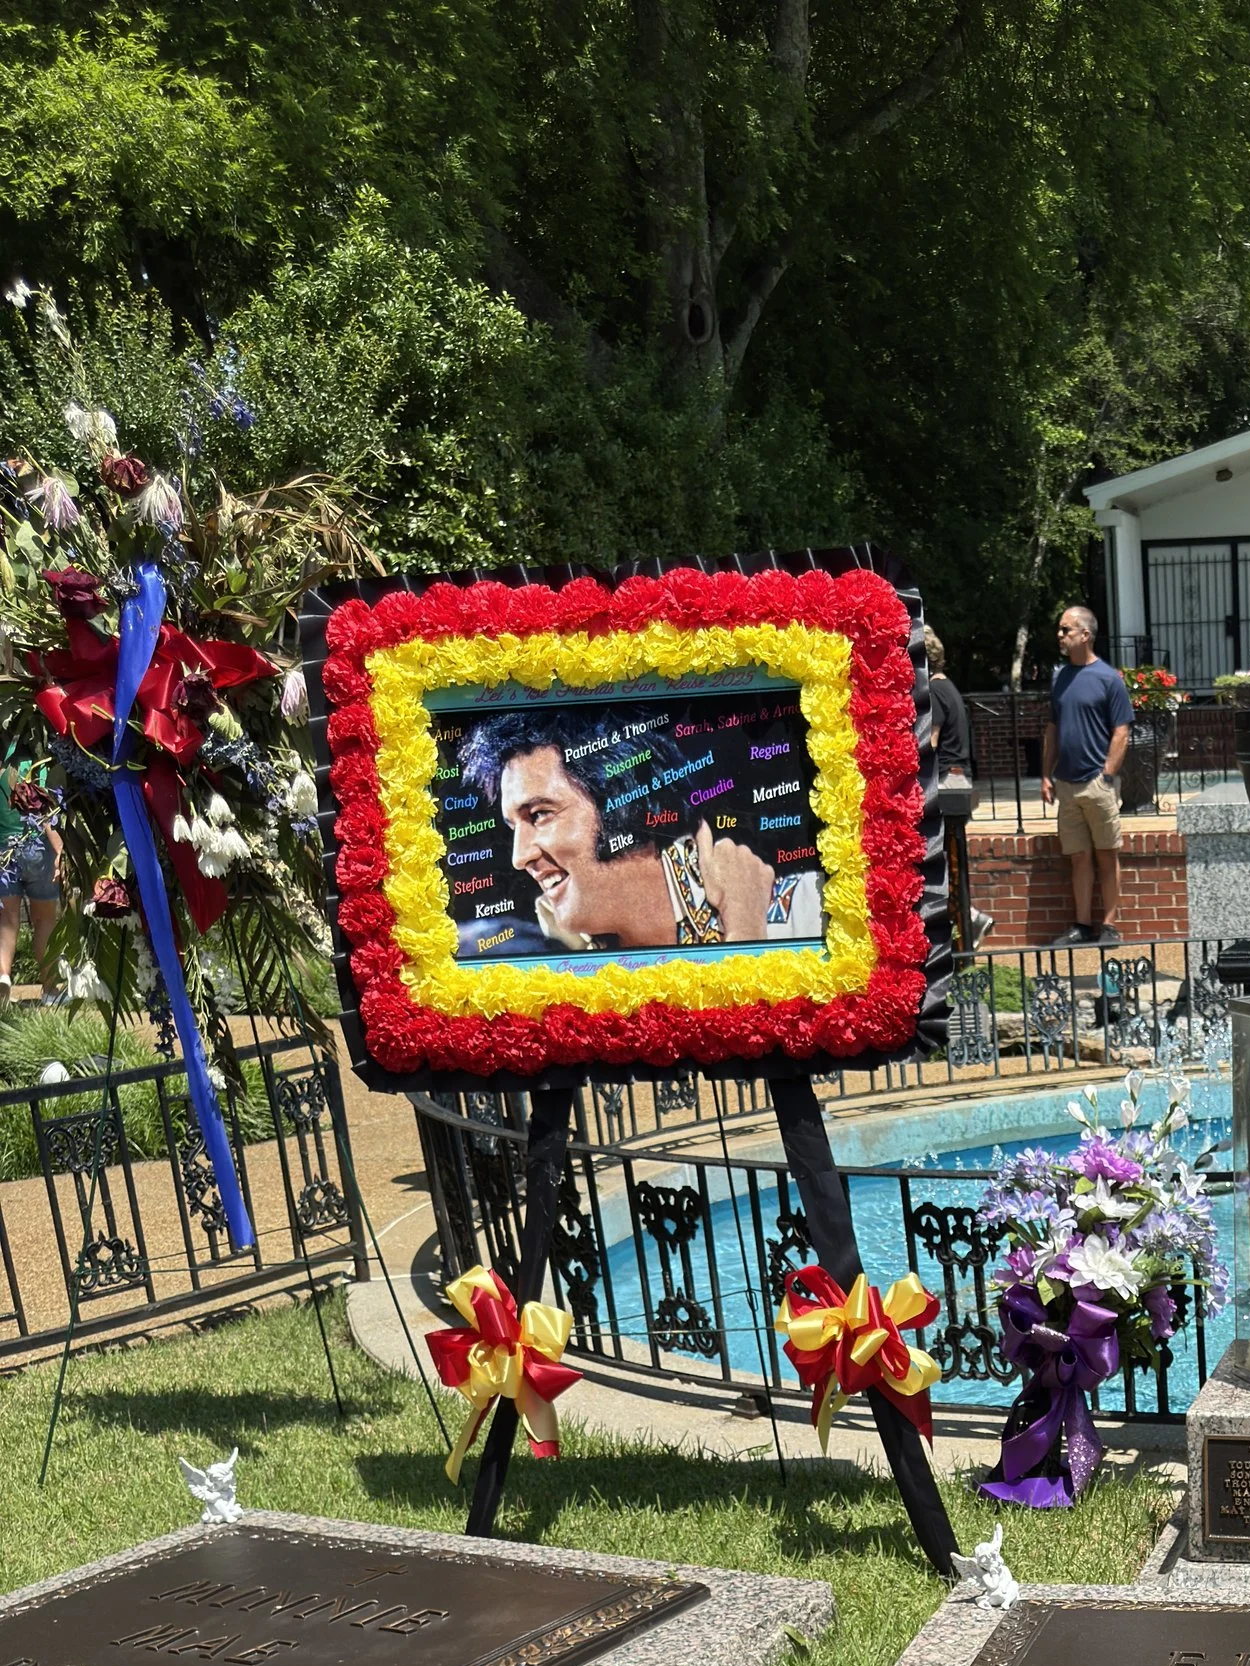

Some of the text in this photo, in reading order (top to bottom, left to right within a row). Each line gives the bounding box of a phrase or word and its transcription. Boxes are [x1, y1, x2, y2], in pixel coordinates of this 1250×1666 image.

[622, 680, 656, 693] Fan
[709, 672, 755, 688] 2025
[675, 719, 714, 738] Sarah,
[718, 713, 757, 730] Sabine
[760, 705, 768, 718] &
[435, 727, 462, 741] Anja
[564, 713, 669, 763] Patricia & Thomas
[750, 742, 790, 762] Regina
[437, 765, 460, 780] Rosi
[605, 750, 652, 778] Susanne
[606, 750, 715, 813] Antonia & Eberhard
[690, 777, 734, 807] Claudia
[753, 780, 800, 804] Martina
[444, 794, 478, 810] Cindy
[448, 818, 496, 841] Barbara
[646, 810, 678, 828] Lydia
[717, 816, 737, 829] Ute
[760, 814, 801, 831] Bettina
[609, 832, 634, 854] Elke
[448, 848, 493, 866] Carmen
[777, 846, 816, 864] Rosina
[454, 874, 494, 895] Stefani
[476, 899, 515, 918] Kerstin
[477, 927, 514, 952] Renate
[150, 1579, 451, 1636] MINNIE
[109, 1623, 298, 1666] MAE
